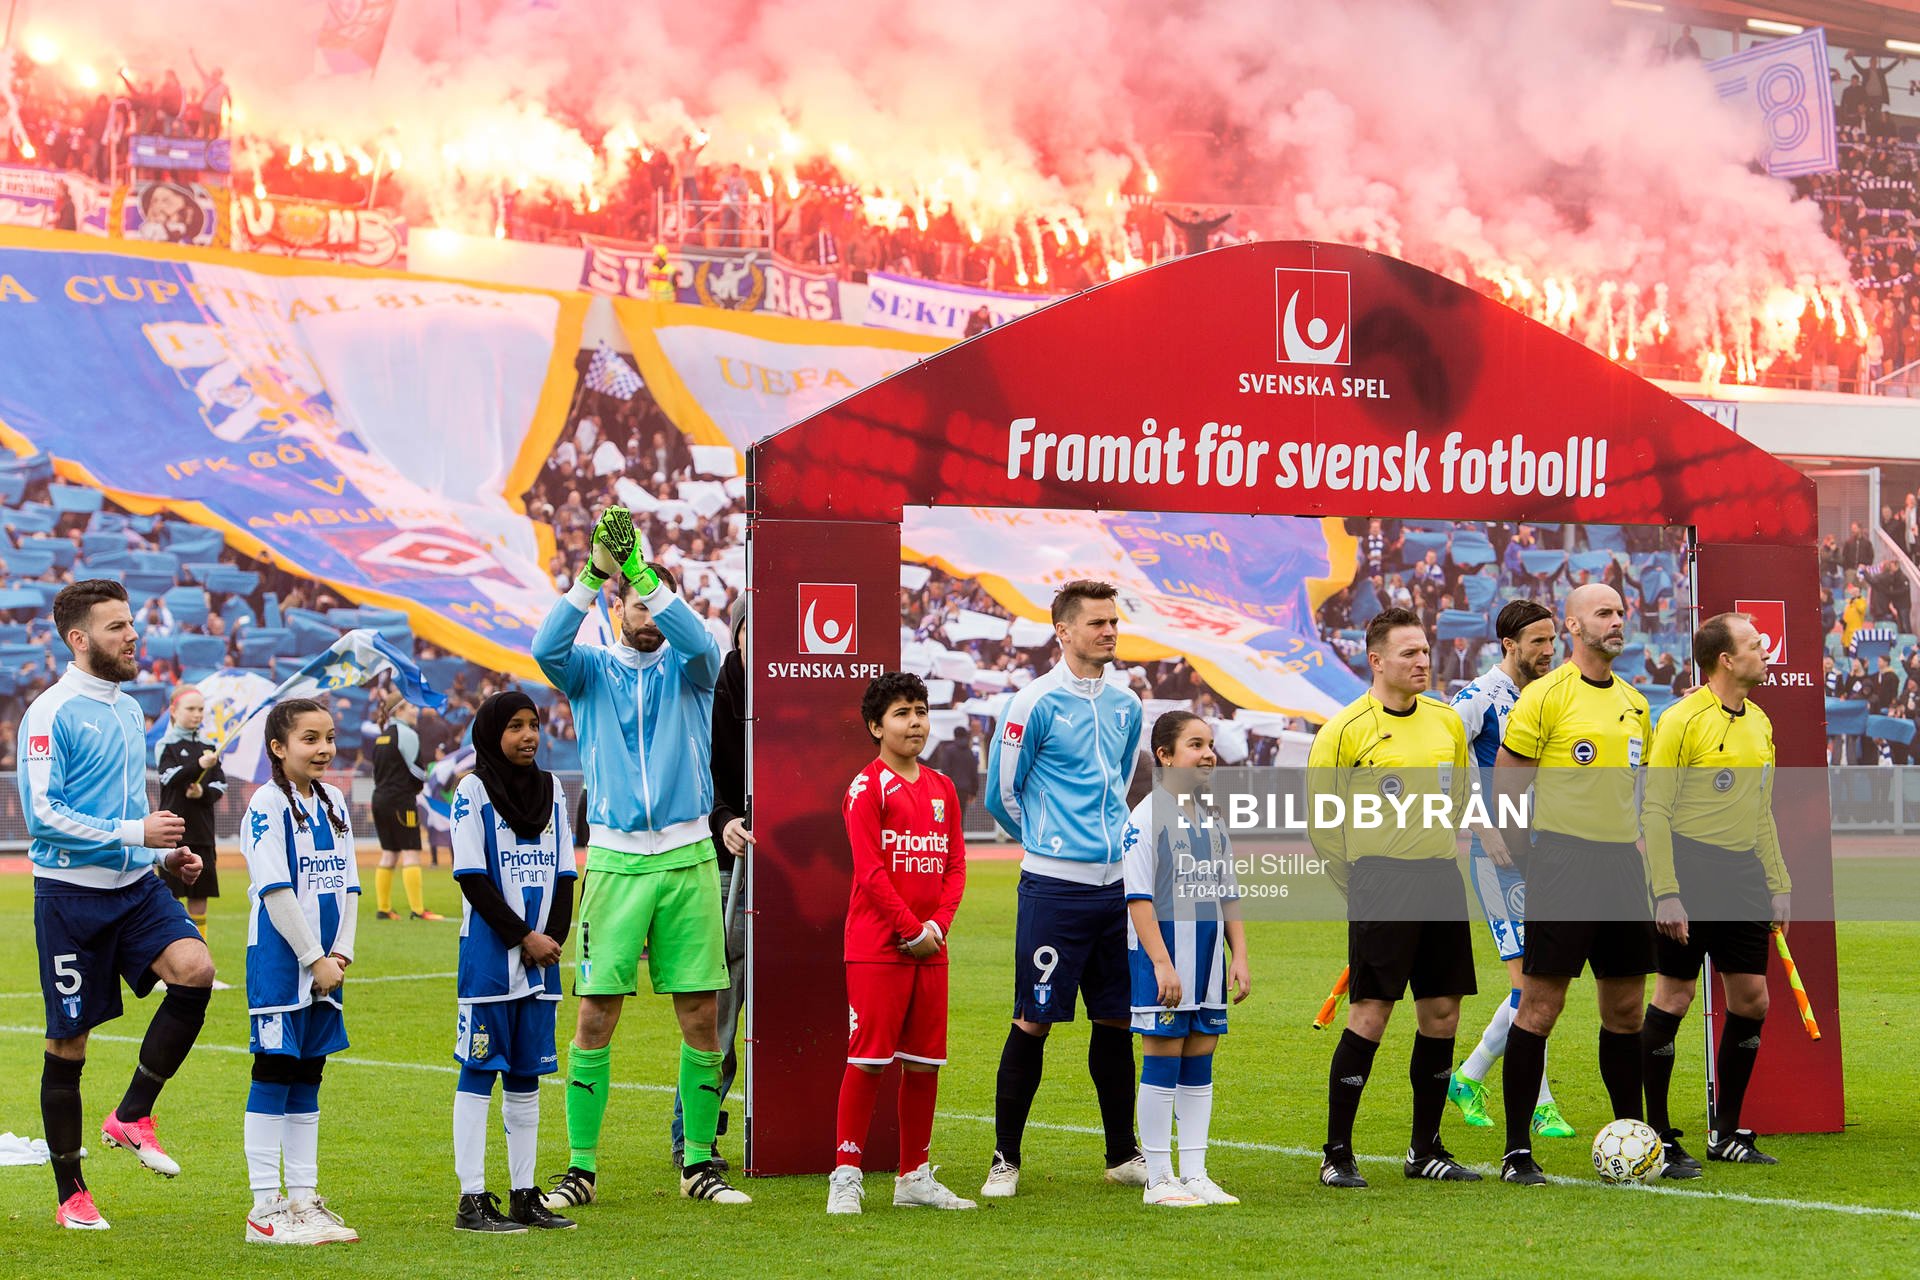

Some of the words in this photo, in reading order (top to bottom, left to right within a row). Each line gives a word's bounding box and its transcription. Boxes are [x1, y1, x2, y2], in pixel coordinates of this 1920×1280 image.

[64, 275, 181, 305] CUP
[714, 355, 860, 397] UEFA
[1238, 373, 1336, 397] SVENSKA
[1341, 377, 1391, 399] SPEL
[1007, 417, 1186, 485] Framåt
[1195, 421, 1270, 488] för
[1276, 429, 1431, 493] svensk
[1439, 431, 1608, 498] fotboll!
[767, 662, 845, 679] SVENSKA
[1781, 672, 1814, 687] SPEL
[1051, 835, 1063, 853] 9
[58, 849, 70, 868] 5
[54, 953, 82, 995] 5
[1033, 945, 1059, 983] 9
